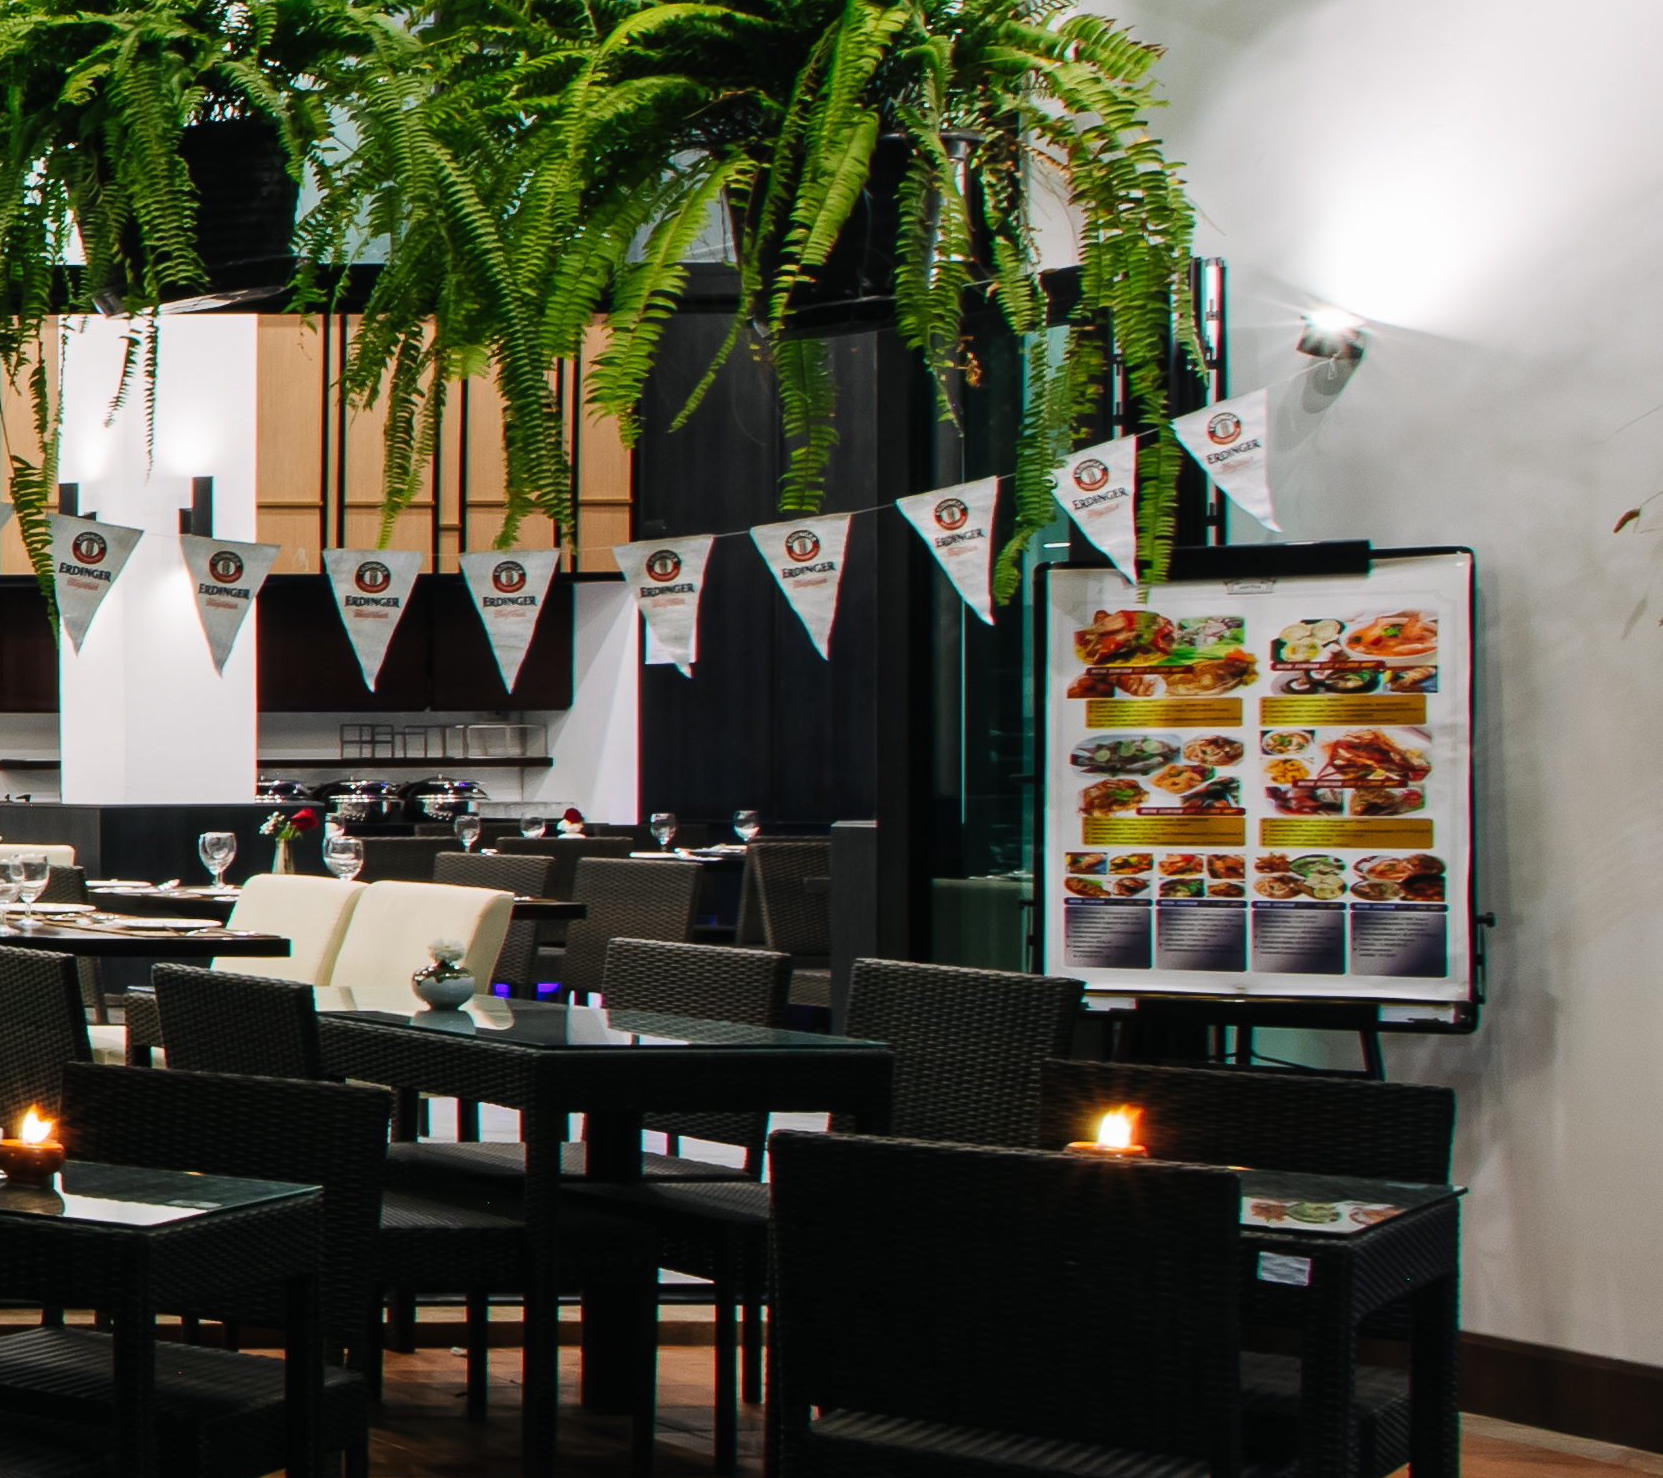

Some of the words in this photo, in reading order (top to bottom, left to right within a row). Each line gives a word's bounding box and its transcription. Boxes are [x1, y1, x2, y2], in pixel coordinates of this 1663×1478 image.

[58, 562, 112, 583] ERDINGER
[198, 582, 250, 600] ERDINGER
[640, 583, 696, 598] ERDINGER
[345, 595, 401, 609] ERDINGER
[483, 595, 538, 607] ERDINGER
